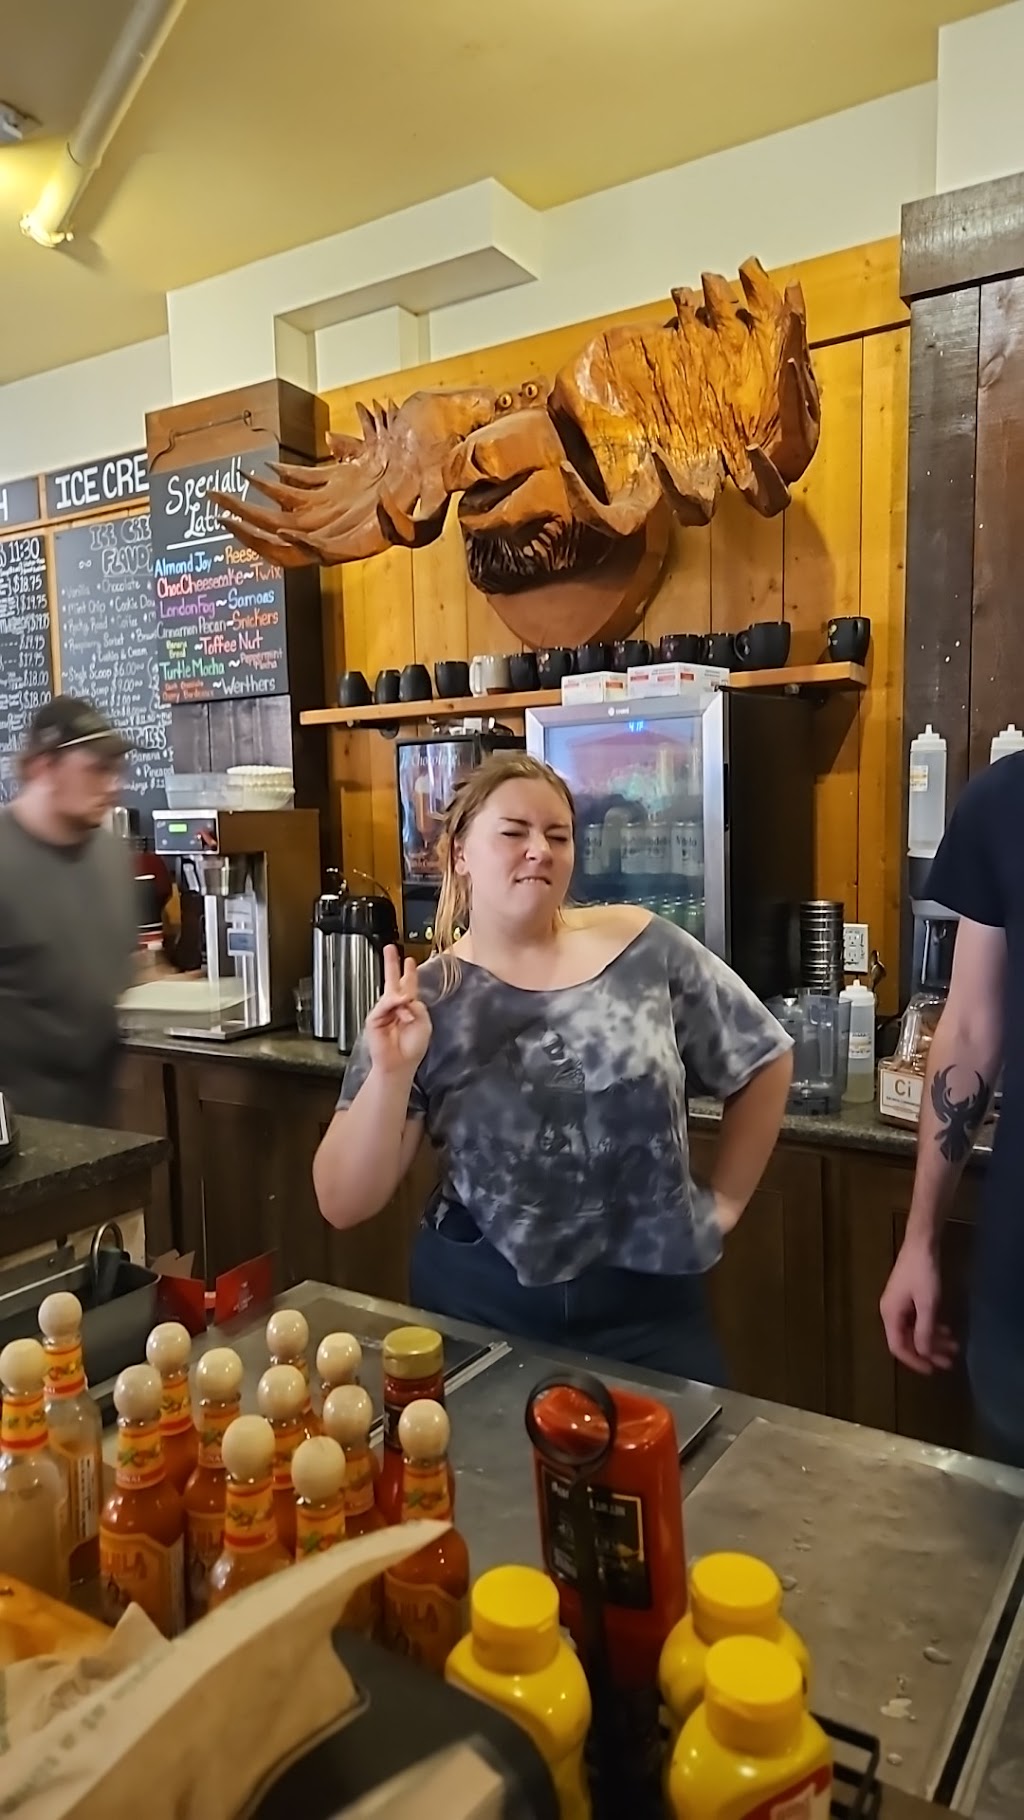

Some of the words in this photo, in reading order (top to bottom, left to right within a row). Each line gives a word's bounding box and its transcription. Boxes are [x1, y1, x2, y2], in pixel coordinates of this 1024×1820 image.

[55, 466, 100, 509] ICE
[102, 453, 150, 499] CRE
[166, 456, 255, 516] Specialty
[89, 522, 117, 551] ICE
[9, 537, 40, 563] 11:30
[154, 553, 194, 578] Almond
[194, 551, 212, 573] Joy
[250, 562, 282, 582] Twix
[13, 573, 42, 594] $18.75
[102, 579, 140, 593] Chocolate
[67, 601, 86, 615] Mint
[88, 600, 106, 618] Chip
[115, 596, 138, 612] Cookie
[228, 587, 275, 609] Samoas
[68, 618, 90, 636] Rocky
[90, 615, 108, 632] Road
[117, 615, 138, 628] Coffee
[156, 621, 198, 639] Cinnamon
[198, 616, 226, 634] Pecan
[232, 607, 279, 631] Snickers
[103, 632, 124, 648] Sorbet
[199, 634, 236, 655] Toffee
[238, 629, 263, 650] Nut
[23, 669, 49, 687] $18.00
[67, 665, 87, 688] Single
[89, 662, 112, 680] Scoop
[159, 659, 191, 680] Turtle
[191, 657, 225, 678] Mocha
[221, 674, 276, 695] Werthers
[23, 690, 51, 709] $18.00
[129, 749, 160, 765] Banana
[894, 1079, 911, 1098] Ci
